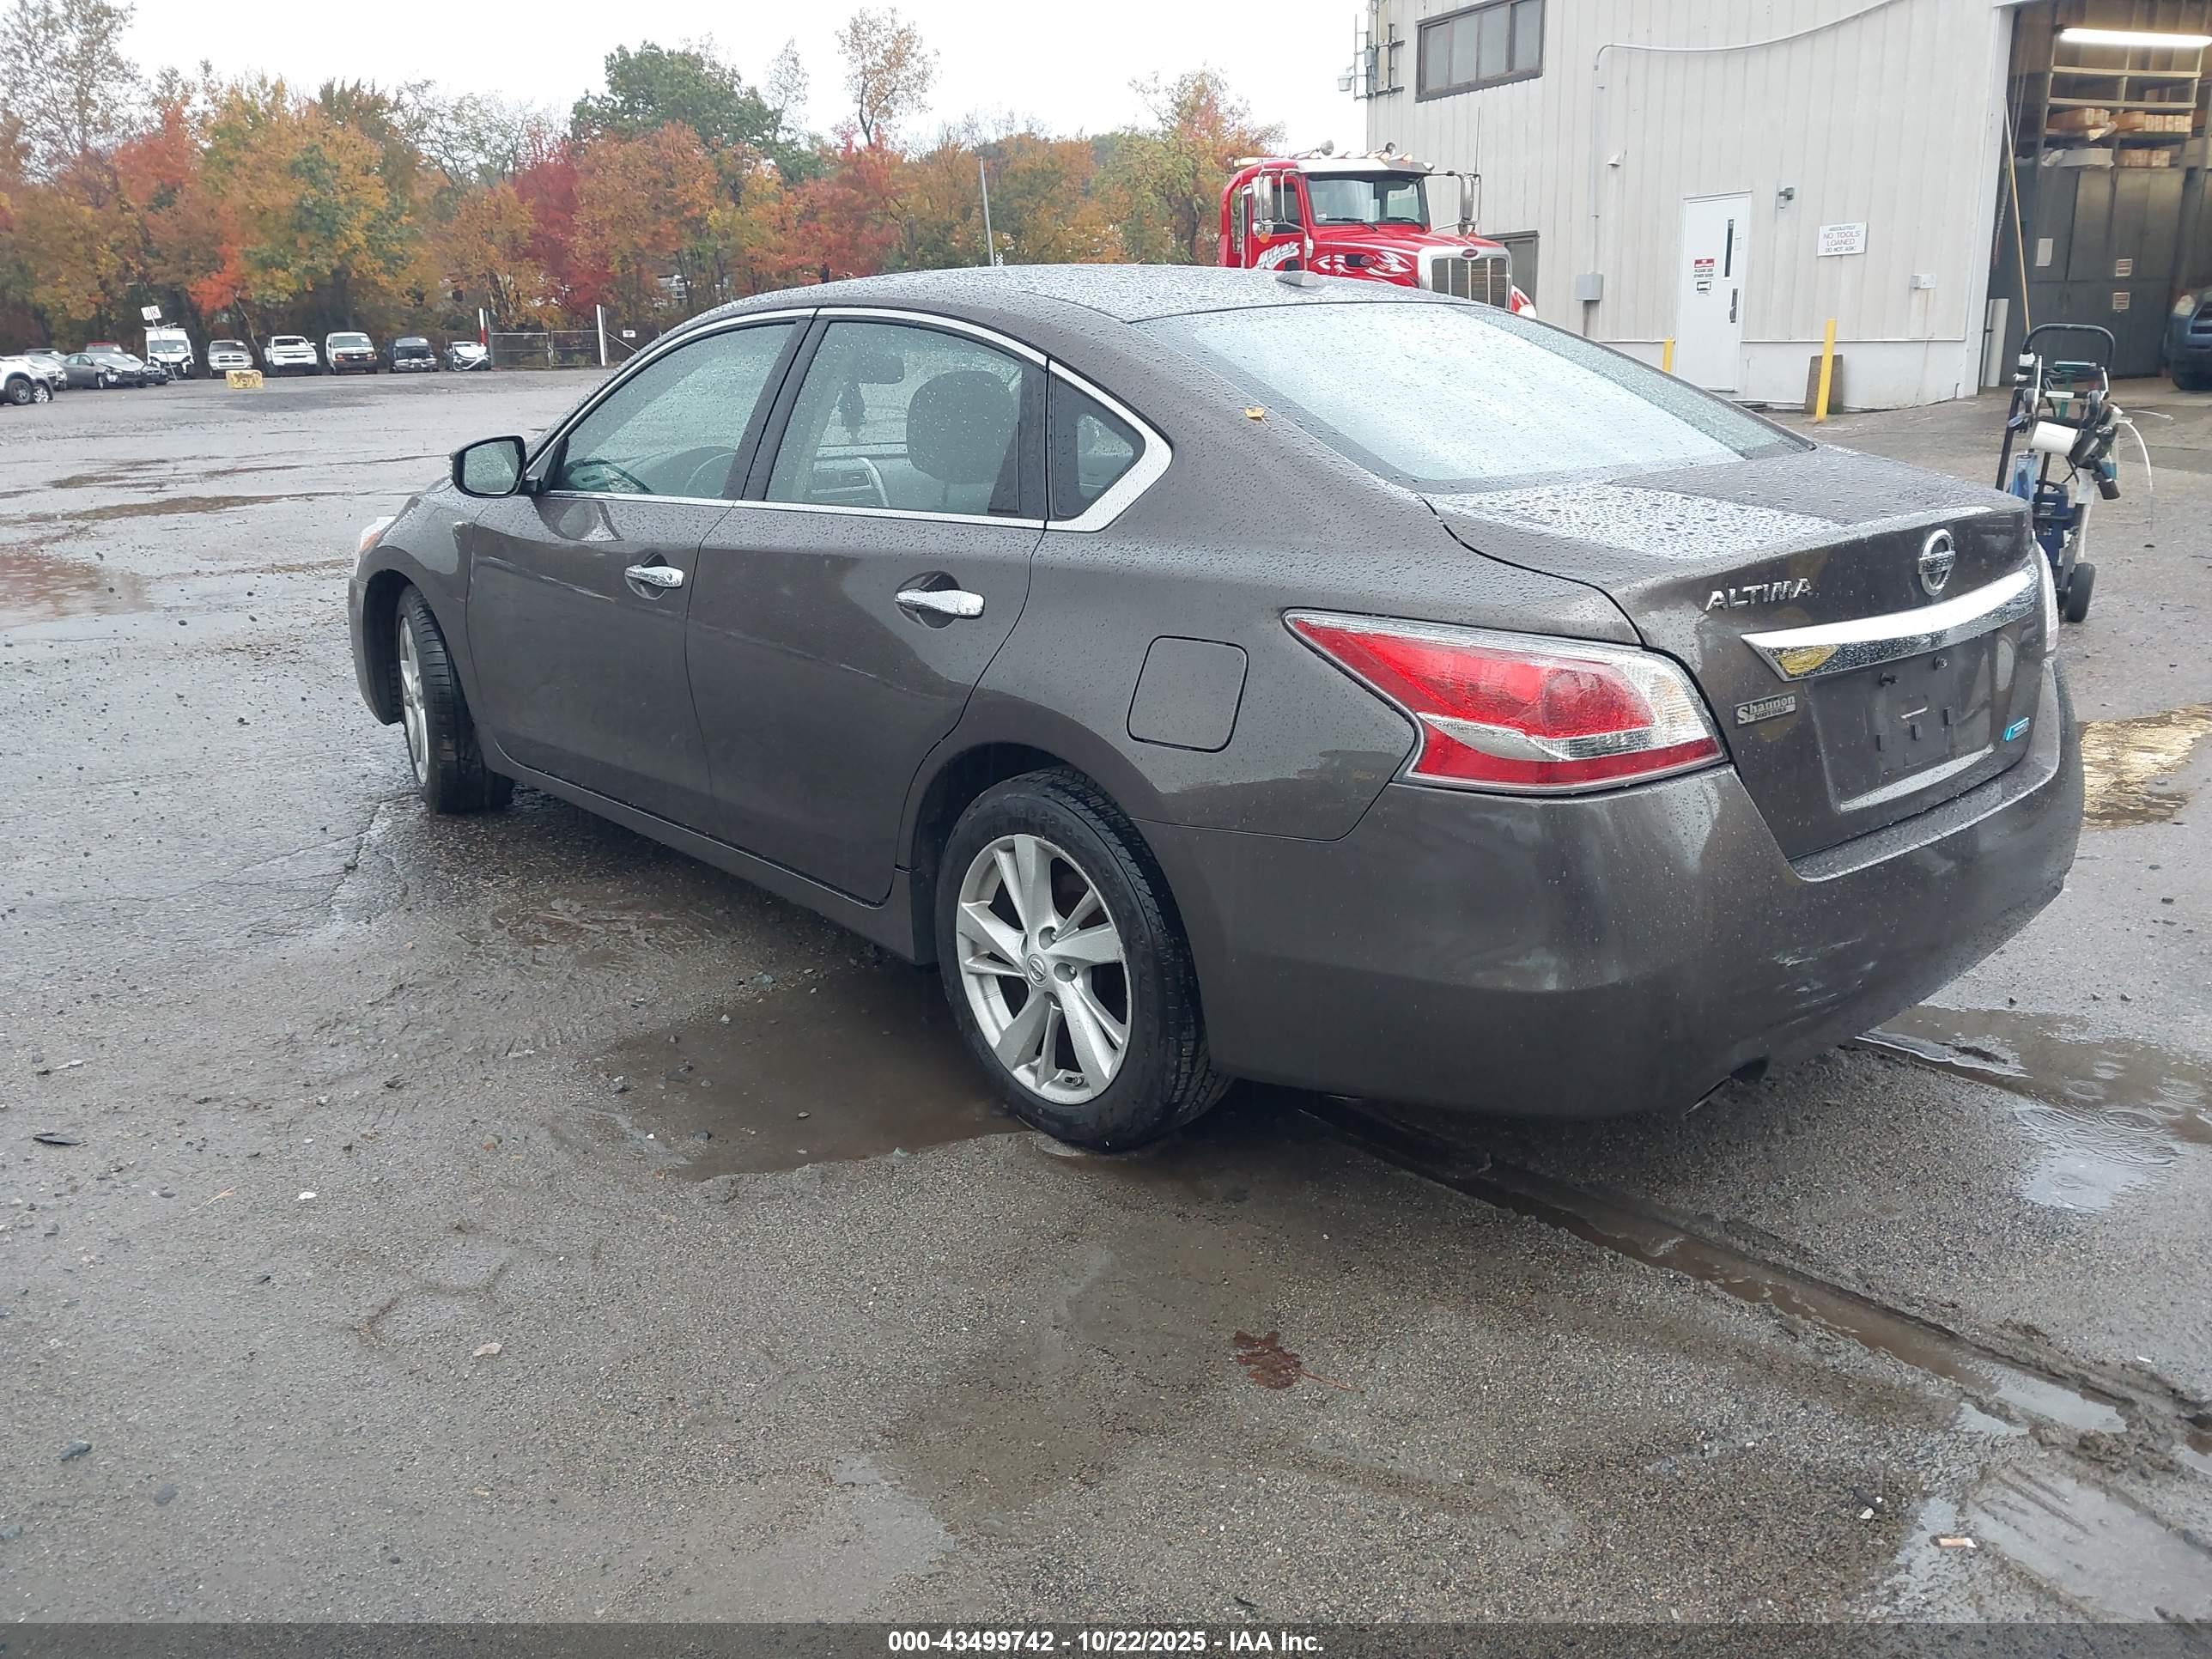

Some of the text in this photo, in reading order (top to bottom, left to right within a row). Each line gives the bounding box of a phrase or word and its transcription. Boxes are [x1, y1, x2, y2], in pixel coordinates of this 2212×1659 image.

[1826, 238, 1856, 247] LOANED
[1836, 230, 1861, 239] TOOLS
[1705, 579, 1812, 611] ALTIMA
[1737, 696, 1796, 724] Shannon
